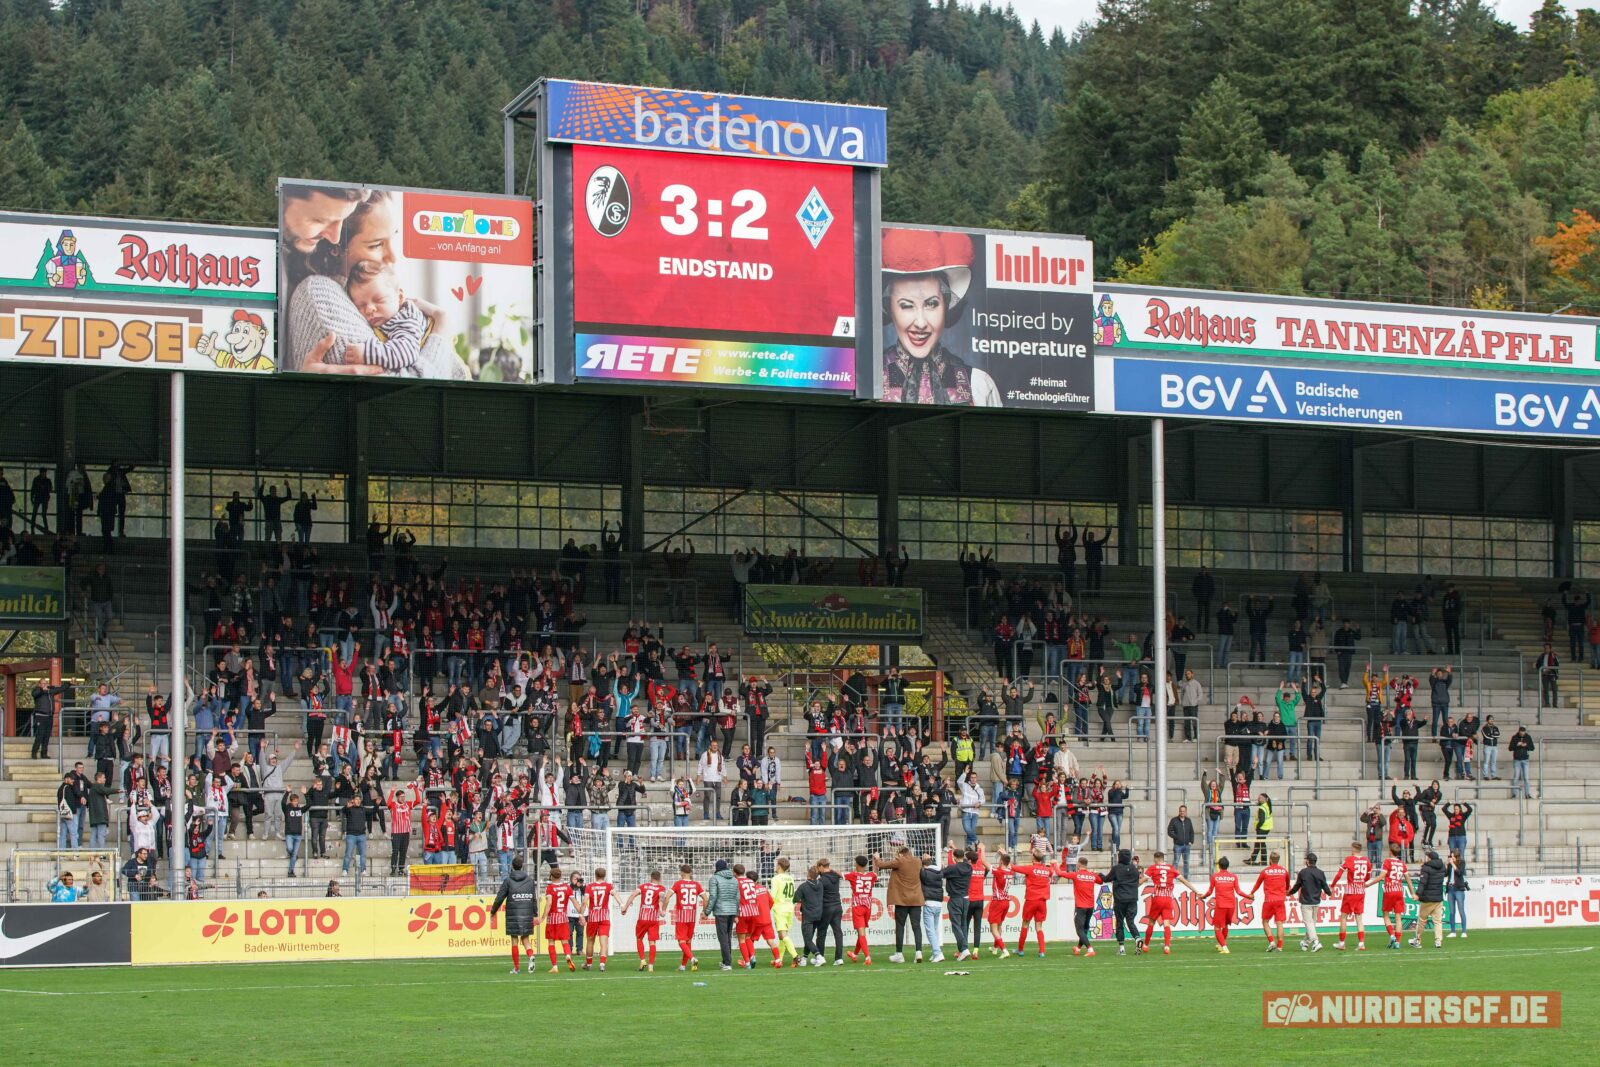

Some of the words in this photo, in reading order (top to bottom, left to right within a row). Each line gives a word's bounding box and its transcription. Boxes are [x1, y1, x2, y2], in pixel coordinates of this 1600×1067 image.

[635, 97, 864, 160] badenova
[660, 184, 768, 240] 3:2
[455, 242, 486, 255] Anfang
[116, 234, 260, 290] Rothaus
[659, 257, 773, 281] ENDSTAND
[995, 243, 1085, 286] huber
[972, 308, 1046, 332] Inspired
[1051, 312, 1074, 334] by
[16, 315, 184, 364] ZIPSE
[1144, 298, 1257, 348] Rothaus
[1276, 317, 1573, 364] TANNENZÄPFLE
[717, 349, 795, 361] www.rete.de
[972, 337, 1087, 359] temperature
[713, 365, 756, 378] Werbe-
[758, 369, 768, 378] &
[770, 368, 851, 382] Folientechnik
[1029, 377, 1067, 388] #heimat
[1007, 390, 1090, 404] #Technologieführer
[1160, 372, 1242, 412] BGV
[1296, 381, 1359, 400] Badische
[1296, 401, 1403, 423] Versicherungen
[1495, 392, 1569, 429] BGV
[751, 610, 917, 631] Schwarzwaldmilch
[1159, 869, 1168, 883] 3
[1353, 864, 1368, 880] 29
[1389, 865, 1404, 880] 26
[783, 882, 794, 899] 40
[855, 880, 872, 893] 23
[1488, 879, 1513, 888] hilzinger
[556, 891, 565, 908] 2
[593, 890, 605, 906] 17
[644, 889, 654, 906] 8
[680, 888, 697, 905] 36
[1489, 896, 1579, 923] hilzinger
[244, 908, 340, 935] LOTTO
[244, 942, 340, 953] Baden-Württemberg
